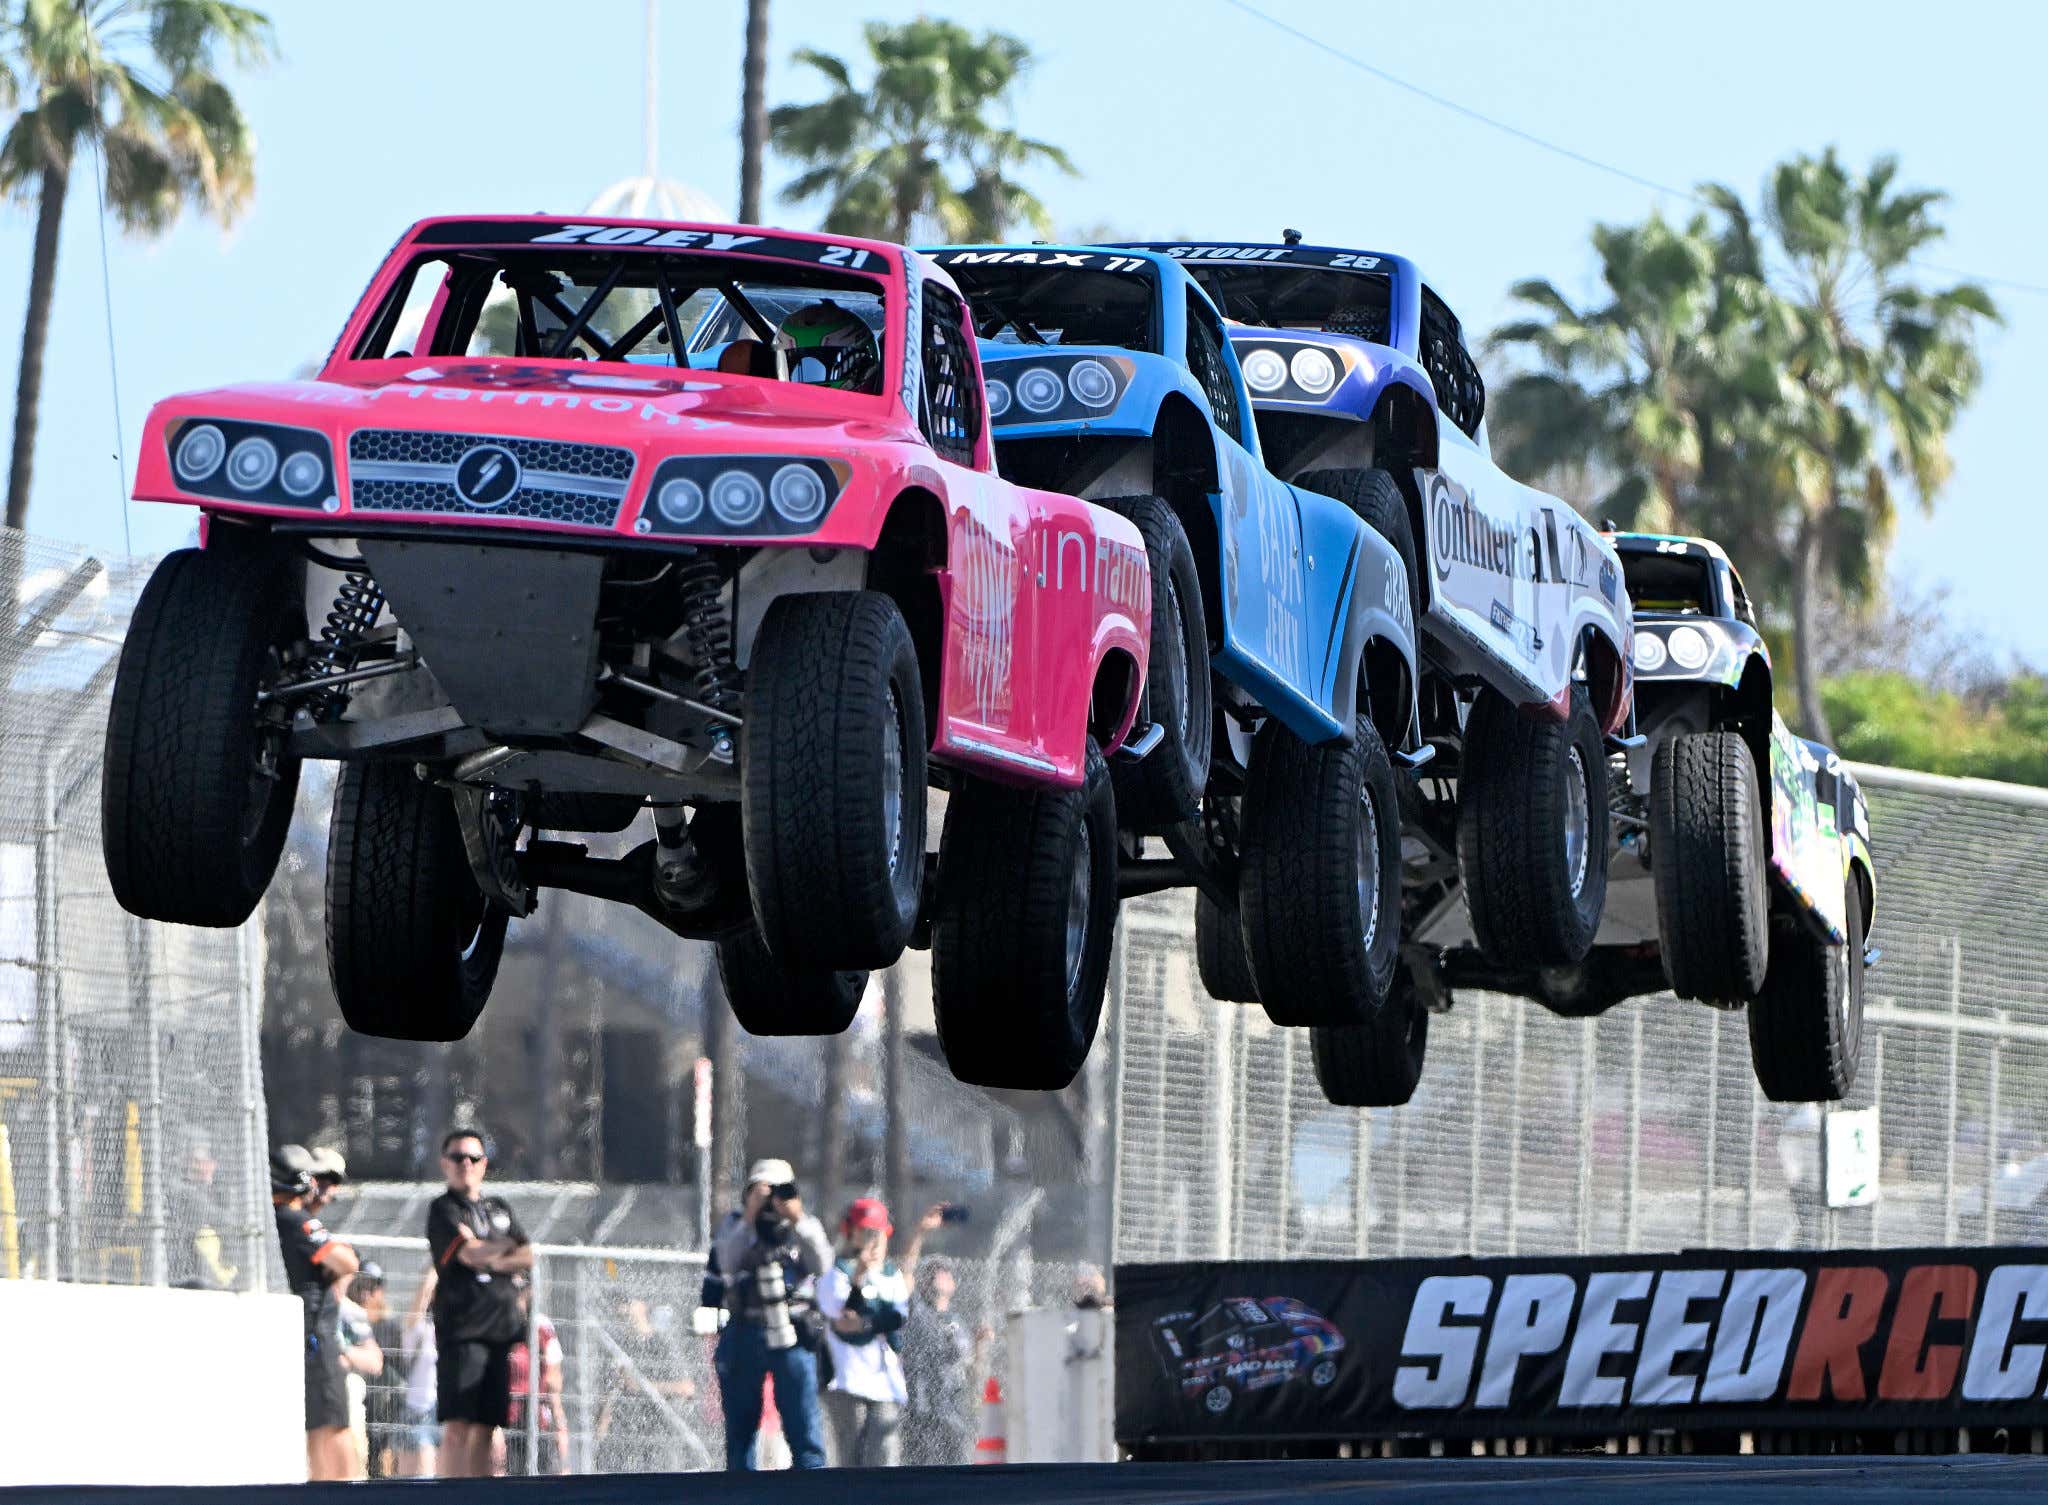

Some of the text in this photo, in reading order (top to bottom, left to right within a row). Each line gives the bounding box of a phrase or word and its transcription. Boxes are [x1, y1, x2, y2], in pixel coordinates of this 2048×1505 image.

[530, 225, 767, 250] ZOEY
[818, 245, 871, 269] 21
[949, 252, 1096, 267] MAX
[1164, 246, 1293, 261] STOUT
[1328, 253, 1381, 270] 28
[1103, 256, 1146, 272] 77
[1430, 474, 1568, 584] Continental
